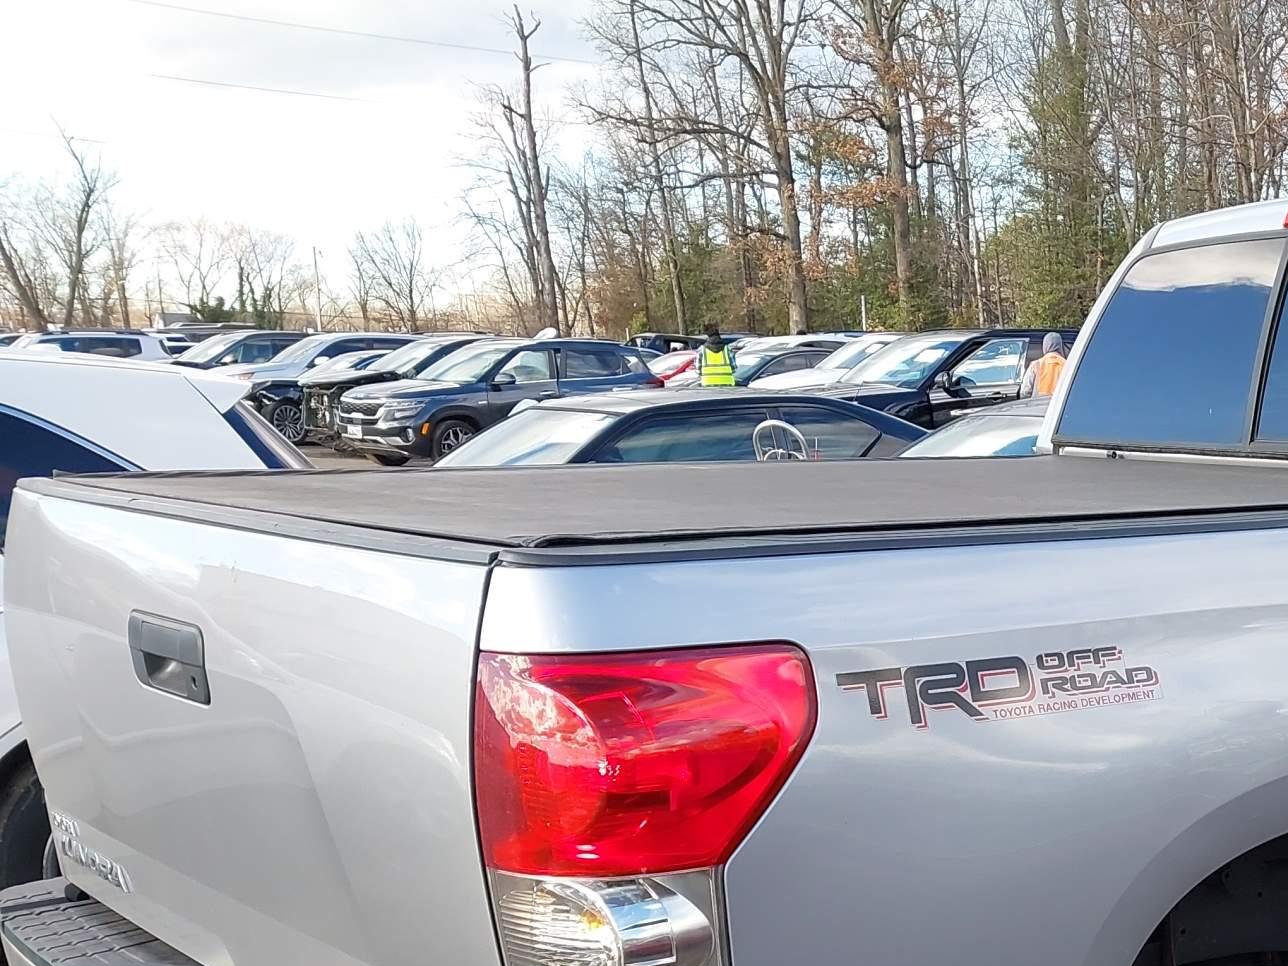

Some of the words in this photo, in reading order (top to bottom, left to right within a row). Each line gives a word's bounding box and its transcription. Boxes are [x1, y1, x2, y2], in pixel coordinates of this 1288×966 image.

[835, 655, 1037, 730] TRD
[1036, 645, 1123, 674] OFF
[1040, 665, 1160, 700] ROAD
[992, 703, 1035, 720] TOYOTA
[1037, 699, 1079, 716] RACING
[1081, 689, 1156, 711] DEVELOPMENT
